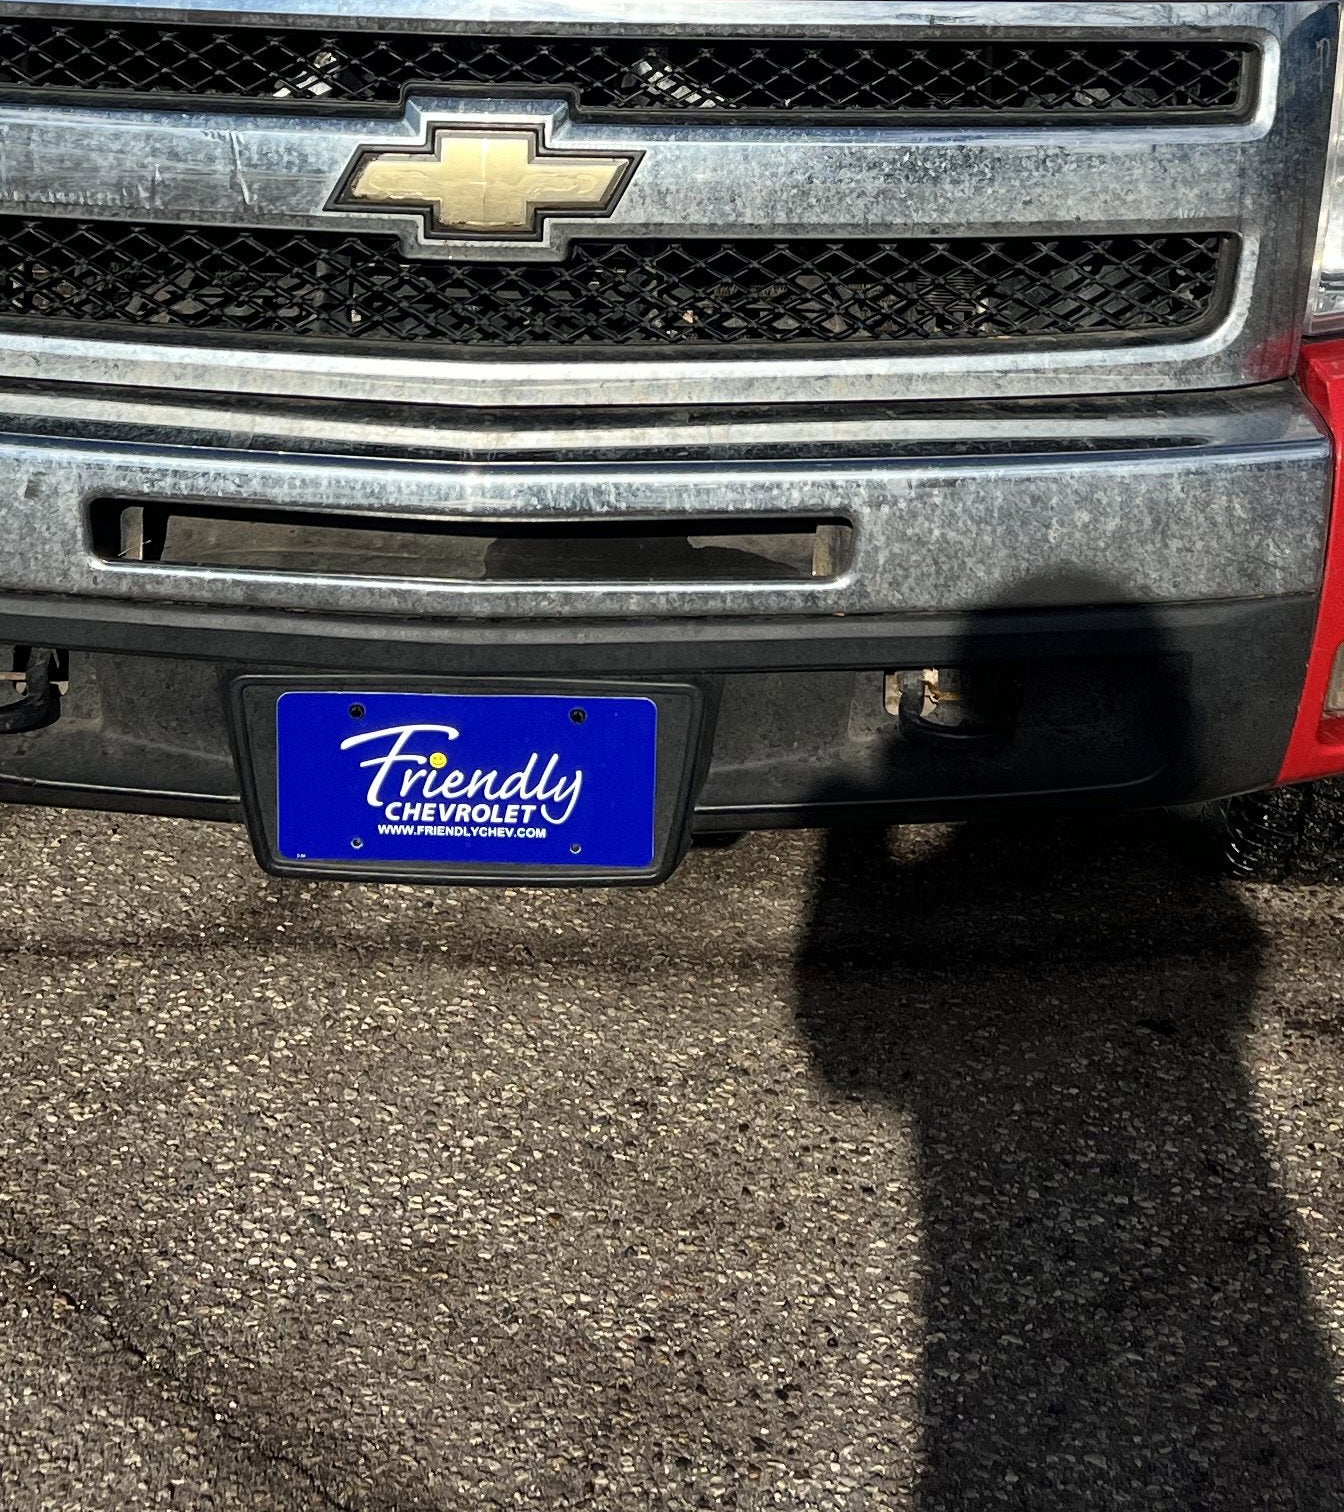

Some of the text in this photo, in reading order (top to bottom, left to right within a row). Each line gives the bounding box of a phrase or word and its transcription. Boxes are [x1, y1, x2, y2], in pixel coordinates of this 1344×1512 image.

[340, 724, 583, 825] Friendly
[385, 801, 537, 824] CHEVROLET
[377, 824, 547, 839] WWW.FRIENDLYCHEV.COM
